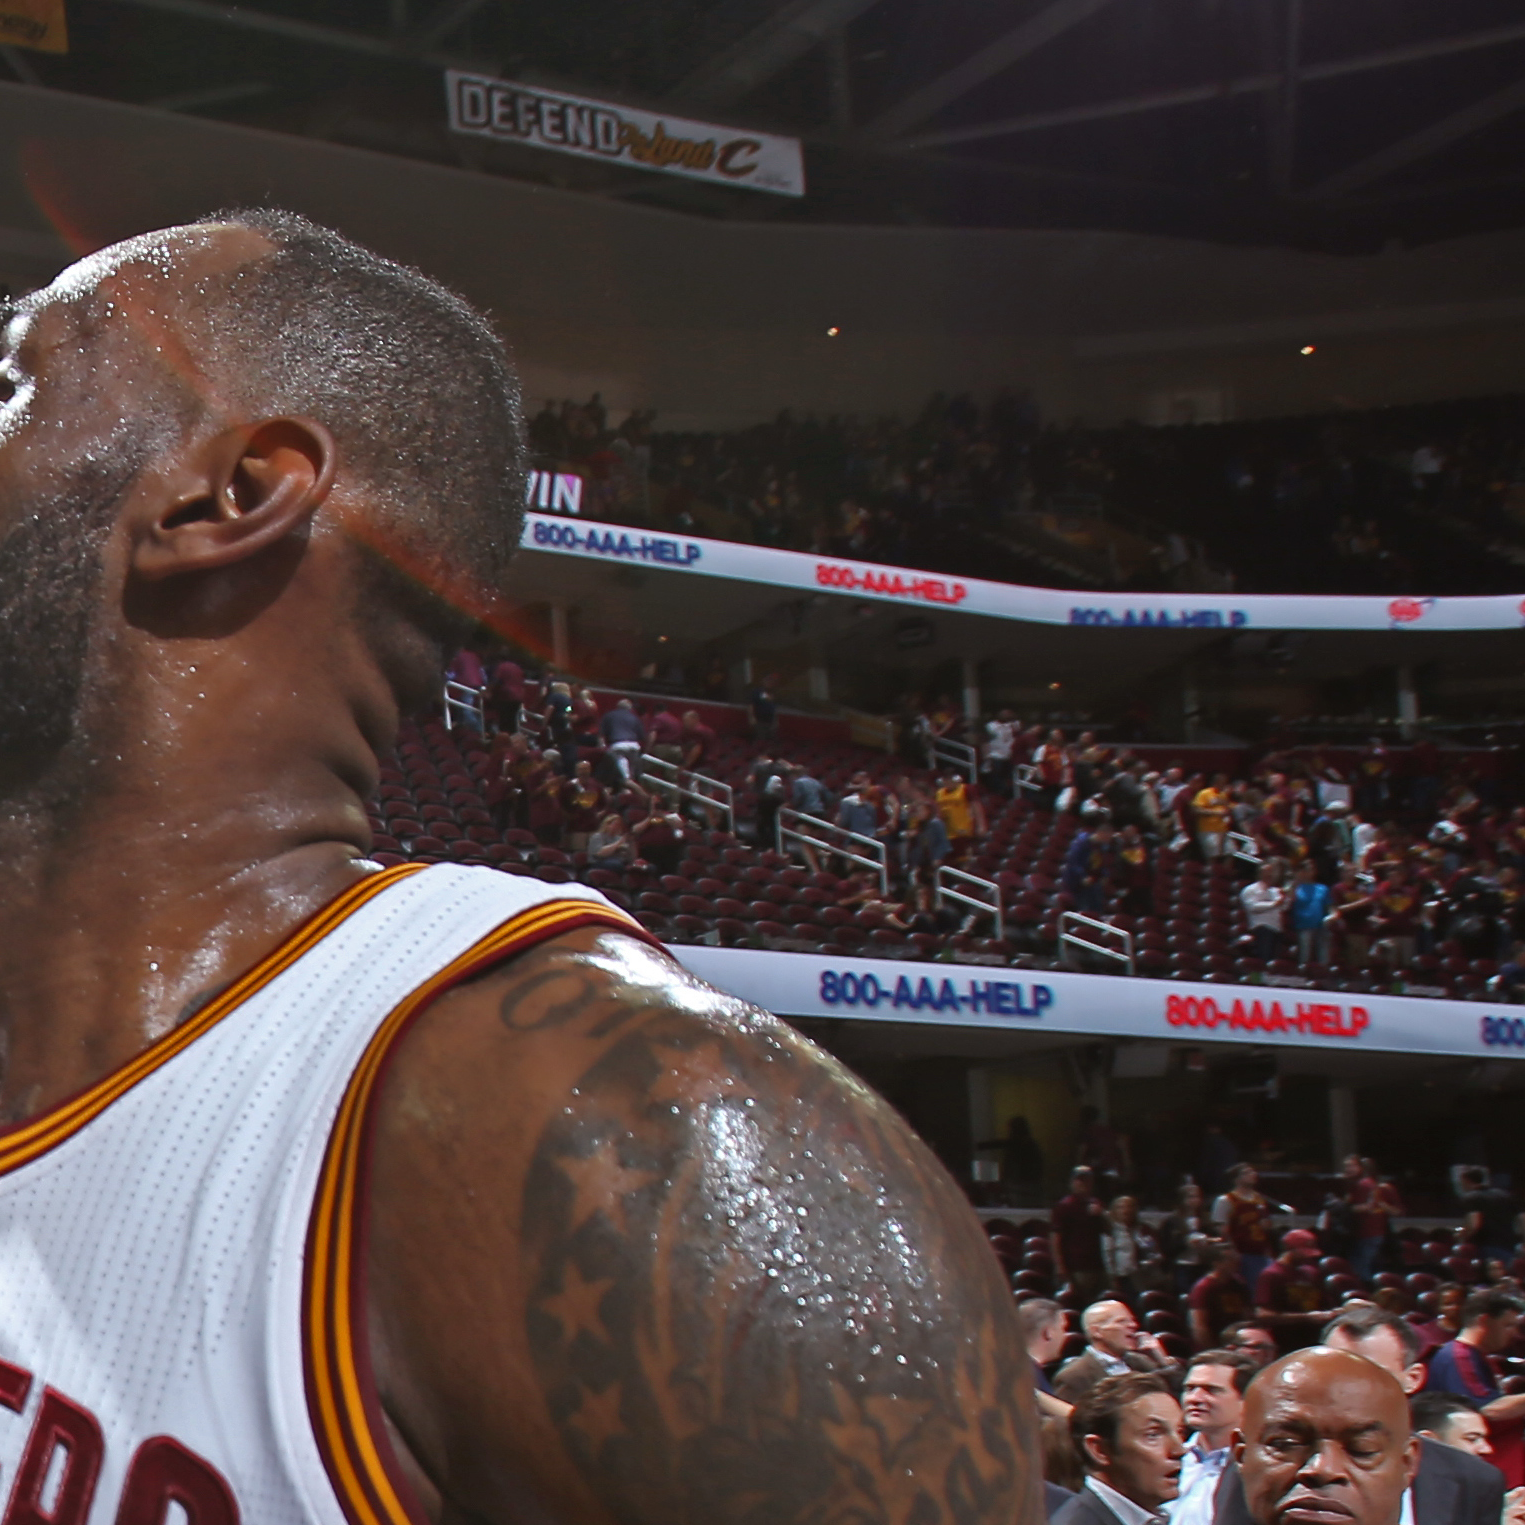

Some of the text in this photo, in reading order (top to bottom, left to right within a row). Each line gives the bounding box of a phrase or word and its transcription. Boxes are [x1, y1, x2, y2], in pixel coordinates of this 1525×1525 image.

[458, 77, 622, 156] DEFEND
[533, 521, 701, 566] 800-AAA-HELP
[816, 563, 966, 605] 800-AAA-HELP
[819, 969, 1054, 1019] 800-AAA-HELP
[1165, 993, 1370, 1038] 800-AAA-HELP
